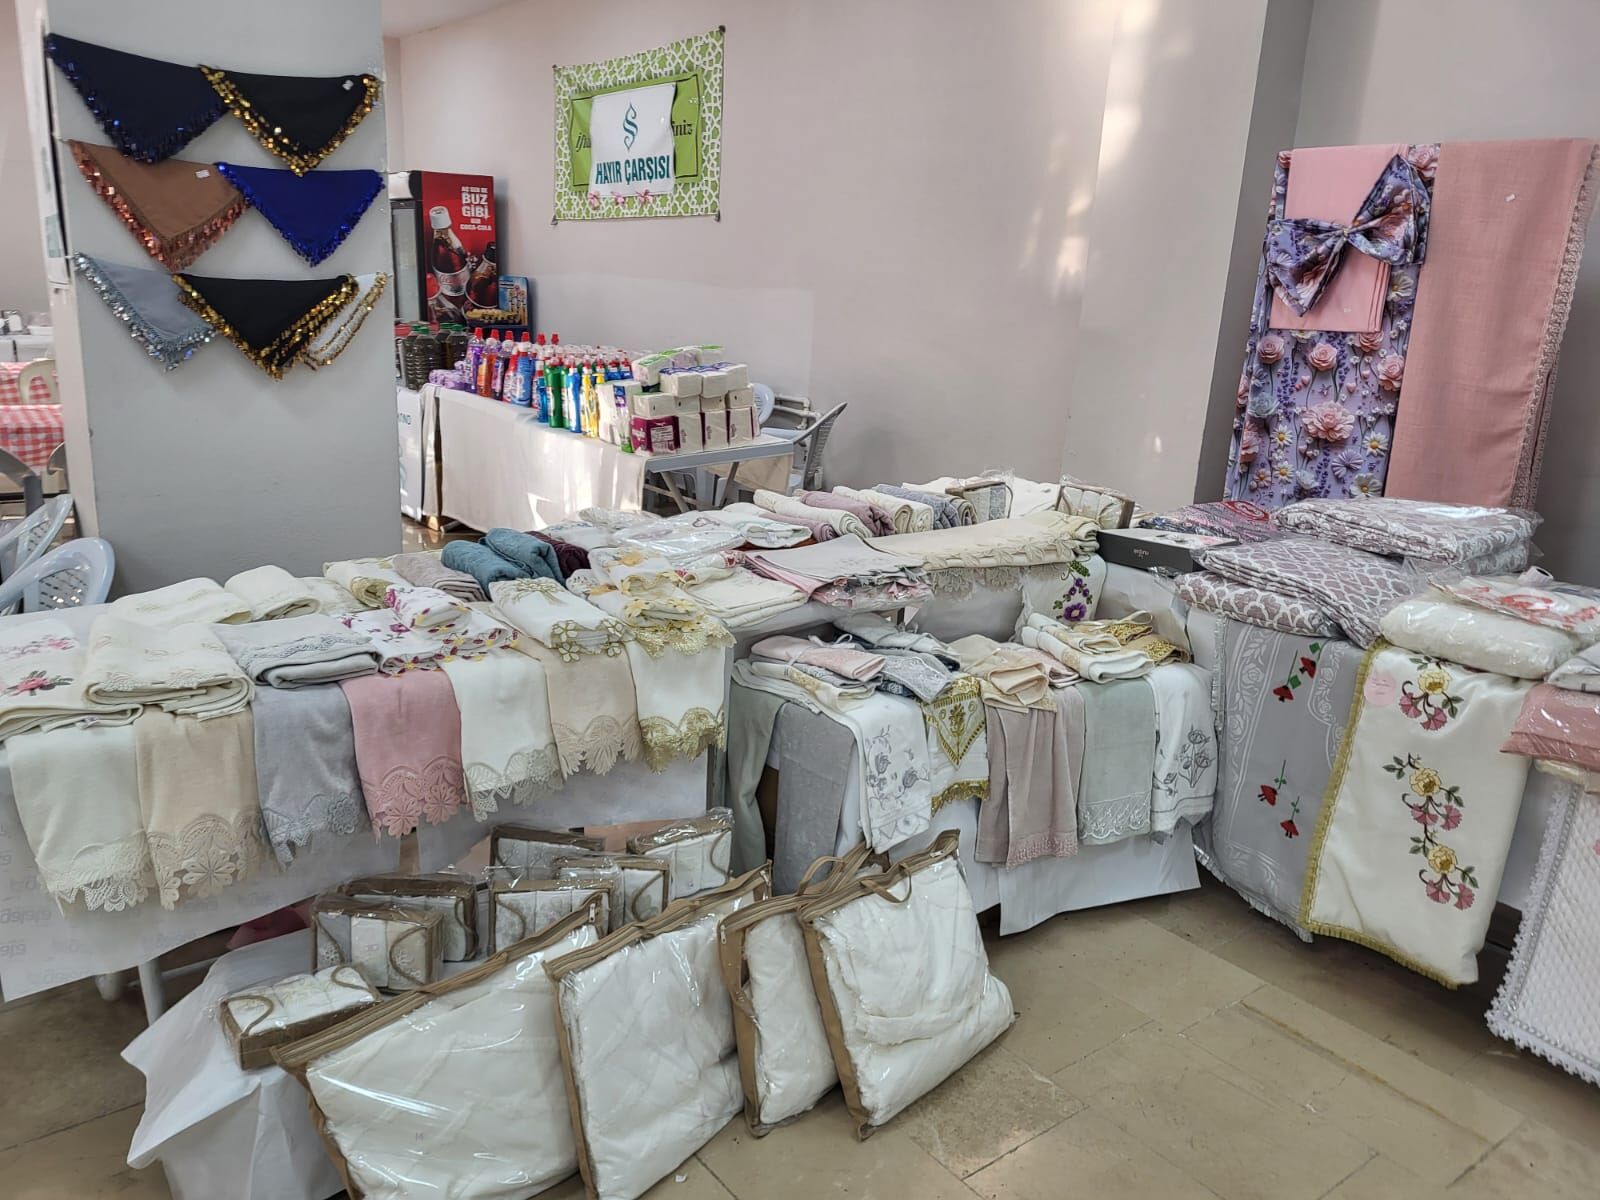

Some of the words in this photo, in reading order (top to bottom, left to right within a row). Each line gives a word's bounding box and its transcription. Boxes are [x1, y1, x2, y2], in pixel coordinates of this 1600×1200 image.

[595, 160, 622, 185] HAYIR
[624, 155, 671, 186] ÇARŞISI
[461, 192, 488, 204] BUZ
